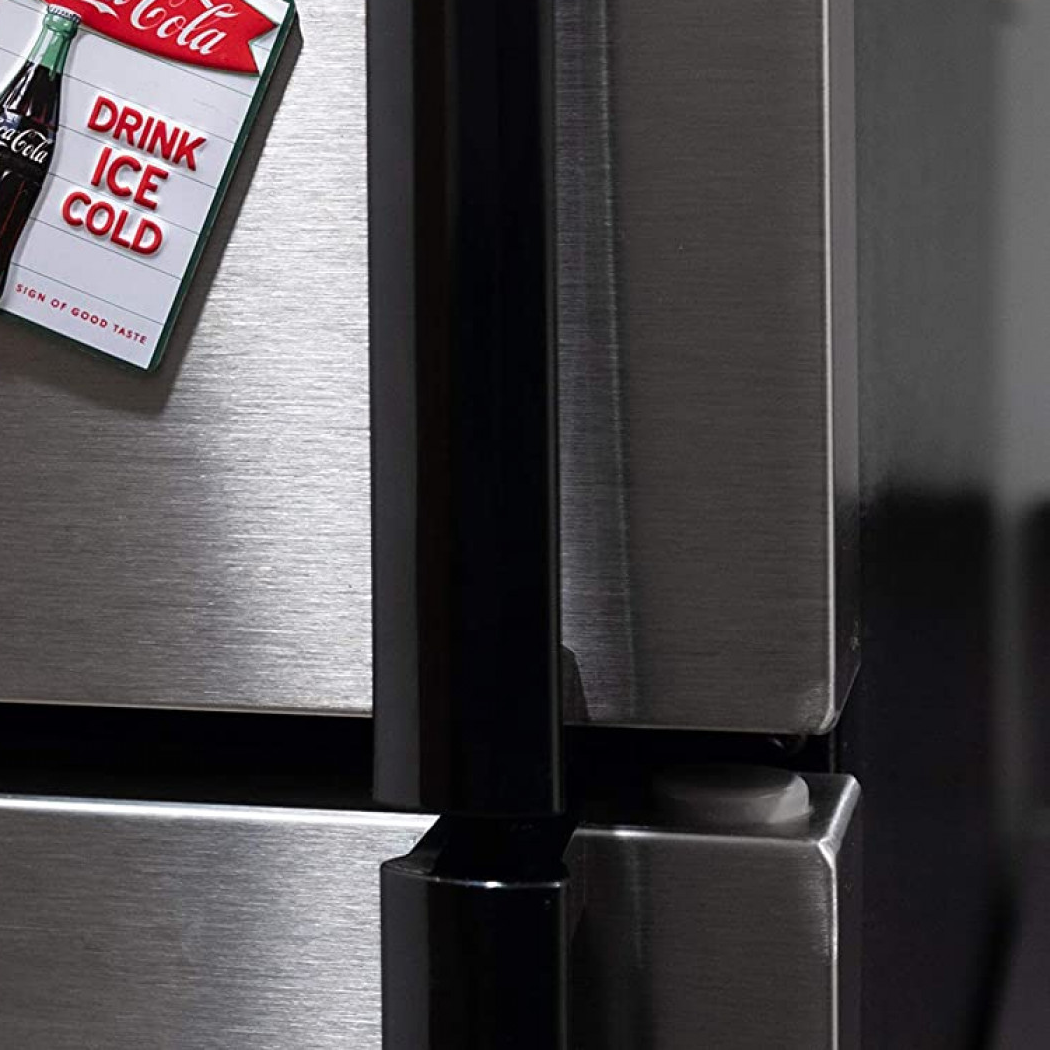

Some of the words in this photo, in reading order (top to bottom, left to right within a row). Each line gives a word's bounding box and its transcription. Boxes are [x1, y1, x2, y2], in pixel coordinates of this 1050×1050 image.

[87, 95, 208, 172] DRINK
[89, 146, 169, 211] ICE
[61, 191, 163, 256] COLD
[15, 283, 46, 302] SIGN
[50, 298, 68, 311] OF
[71, 307, 108, 329] GOOD
[113, 324, 148, 345] TASTE
